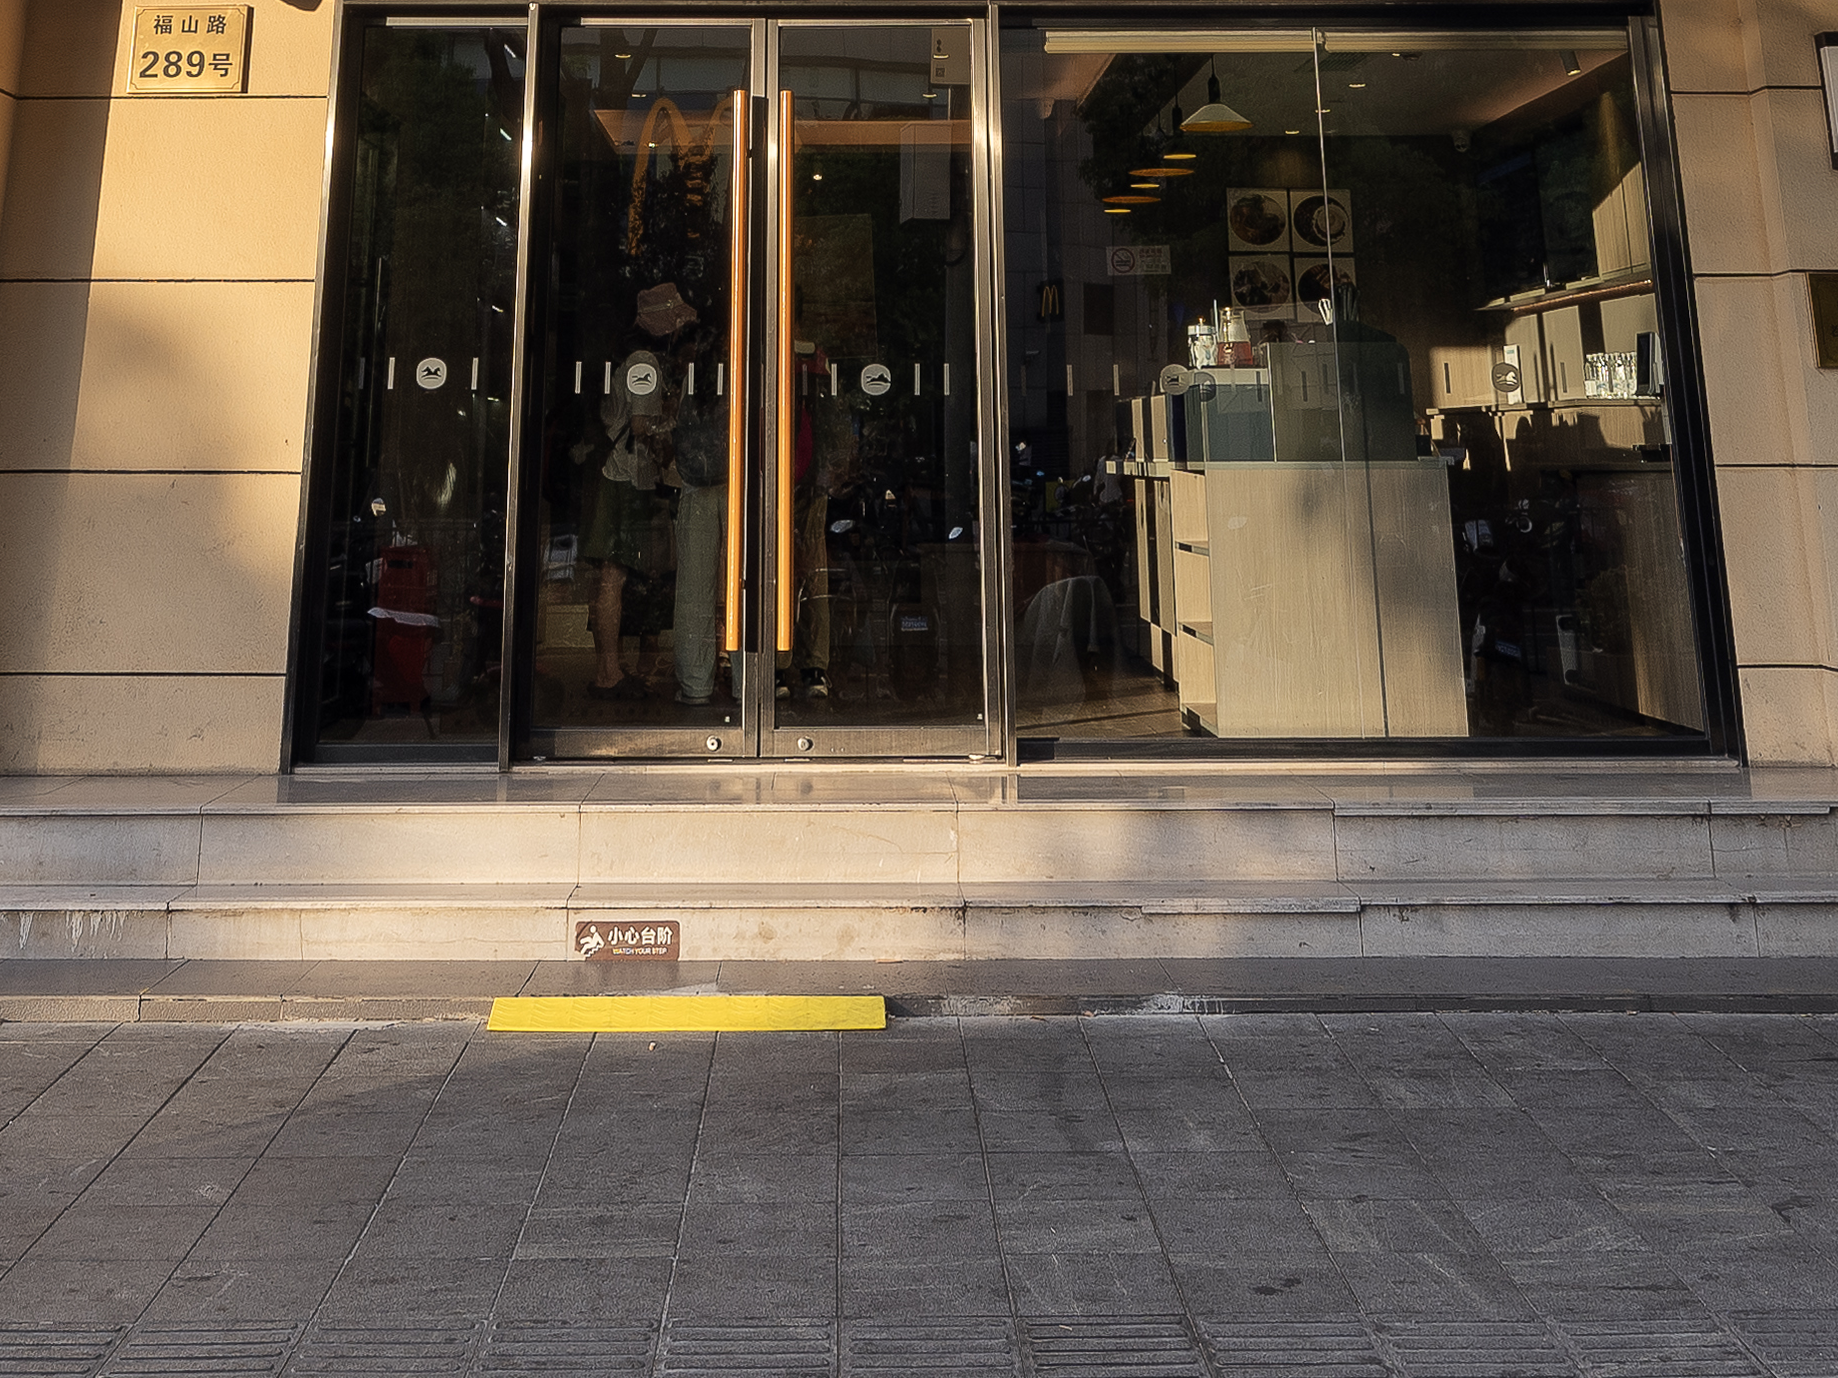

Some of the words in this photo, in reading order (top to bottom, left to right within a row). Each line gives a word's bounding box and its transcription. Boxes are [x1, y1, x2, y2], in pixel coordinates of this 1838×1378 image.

[152, 13, 228, 36] 福山路
[138, 49, 234, 79] 289号
[607, 925, 674, 946] 小心台阶
